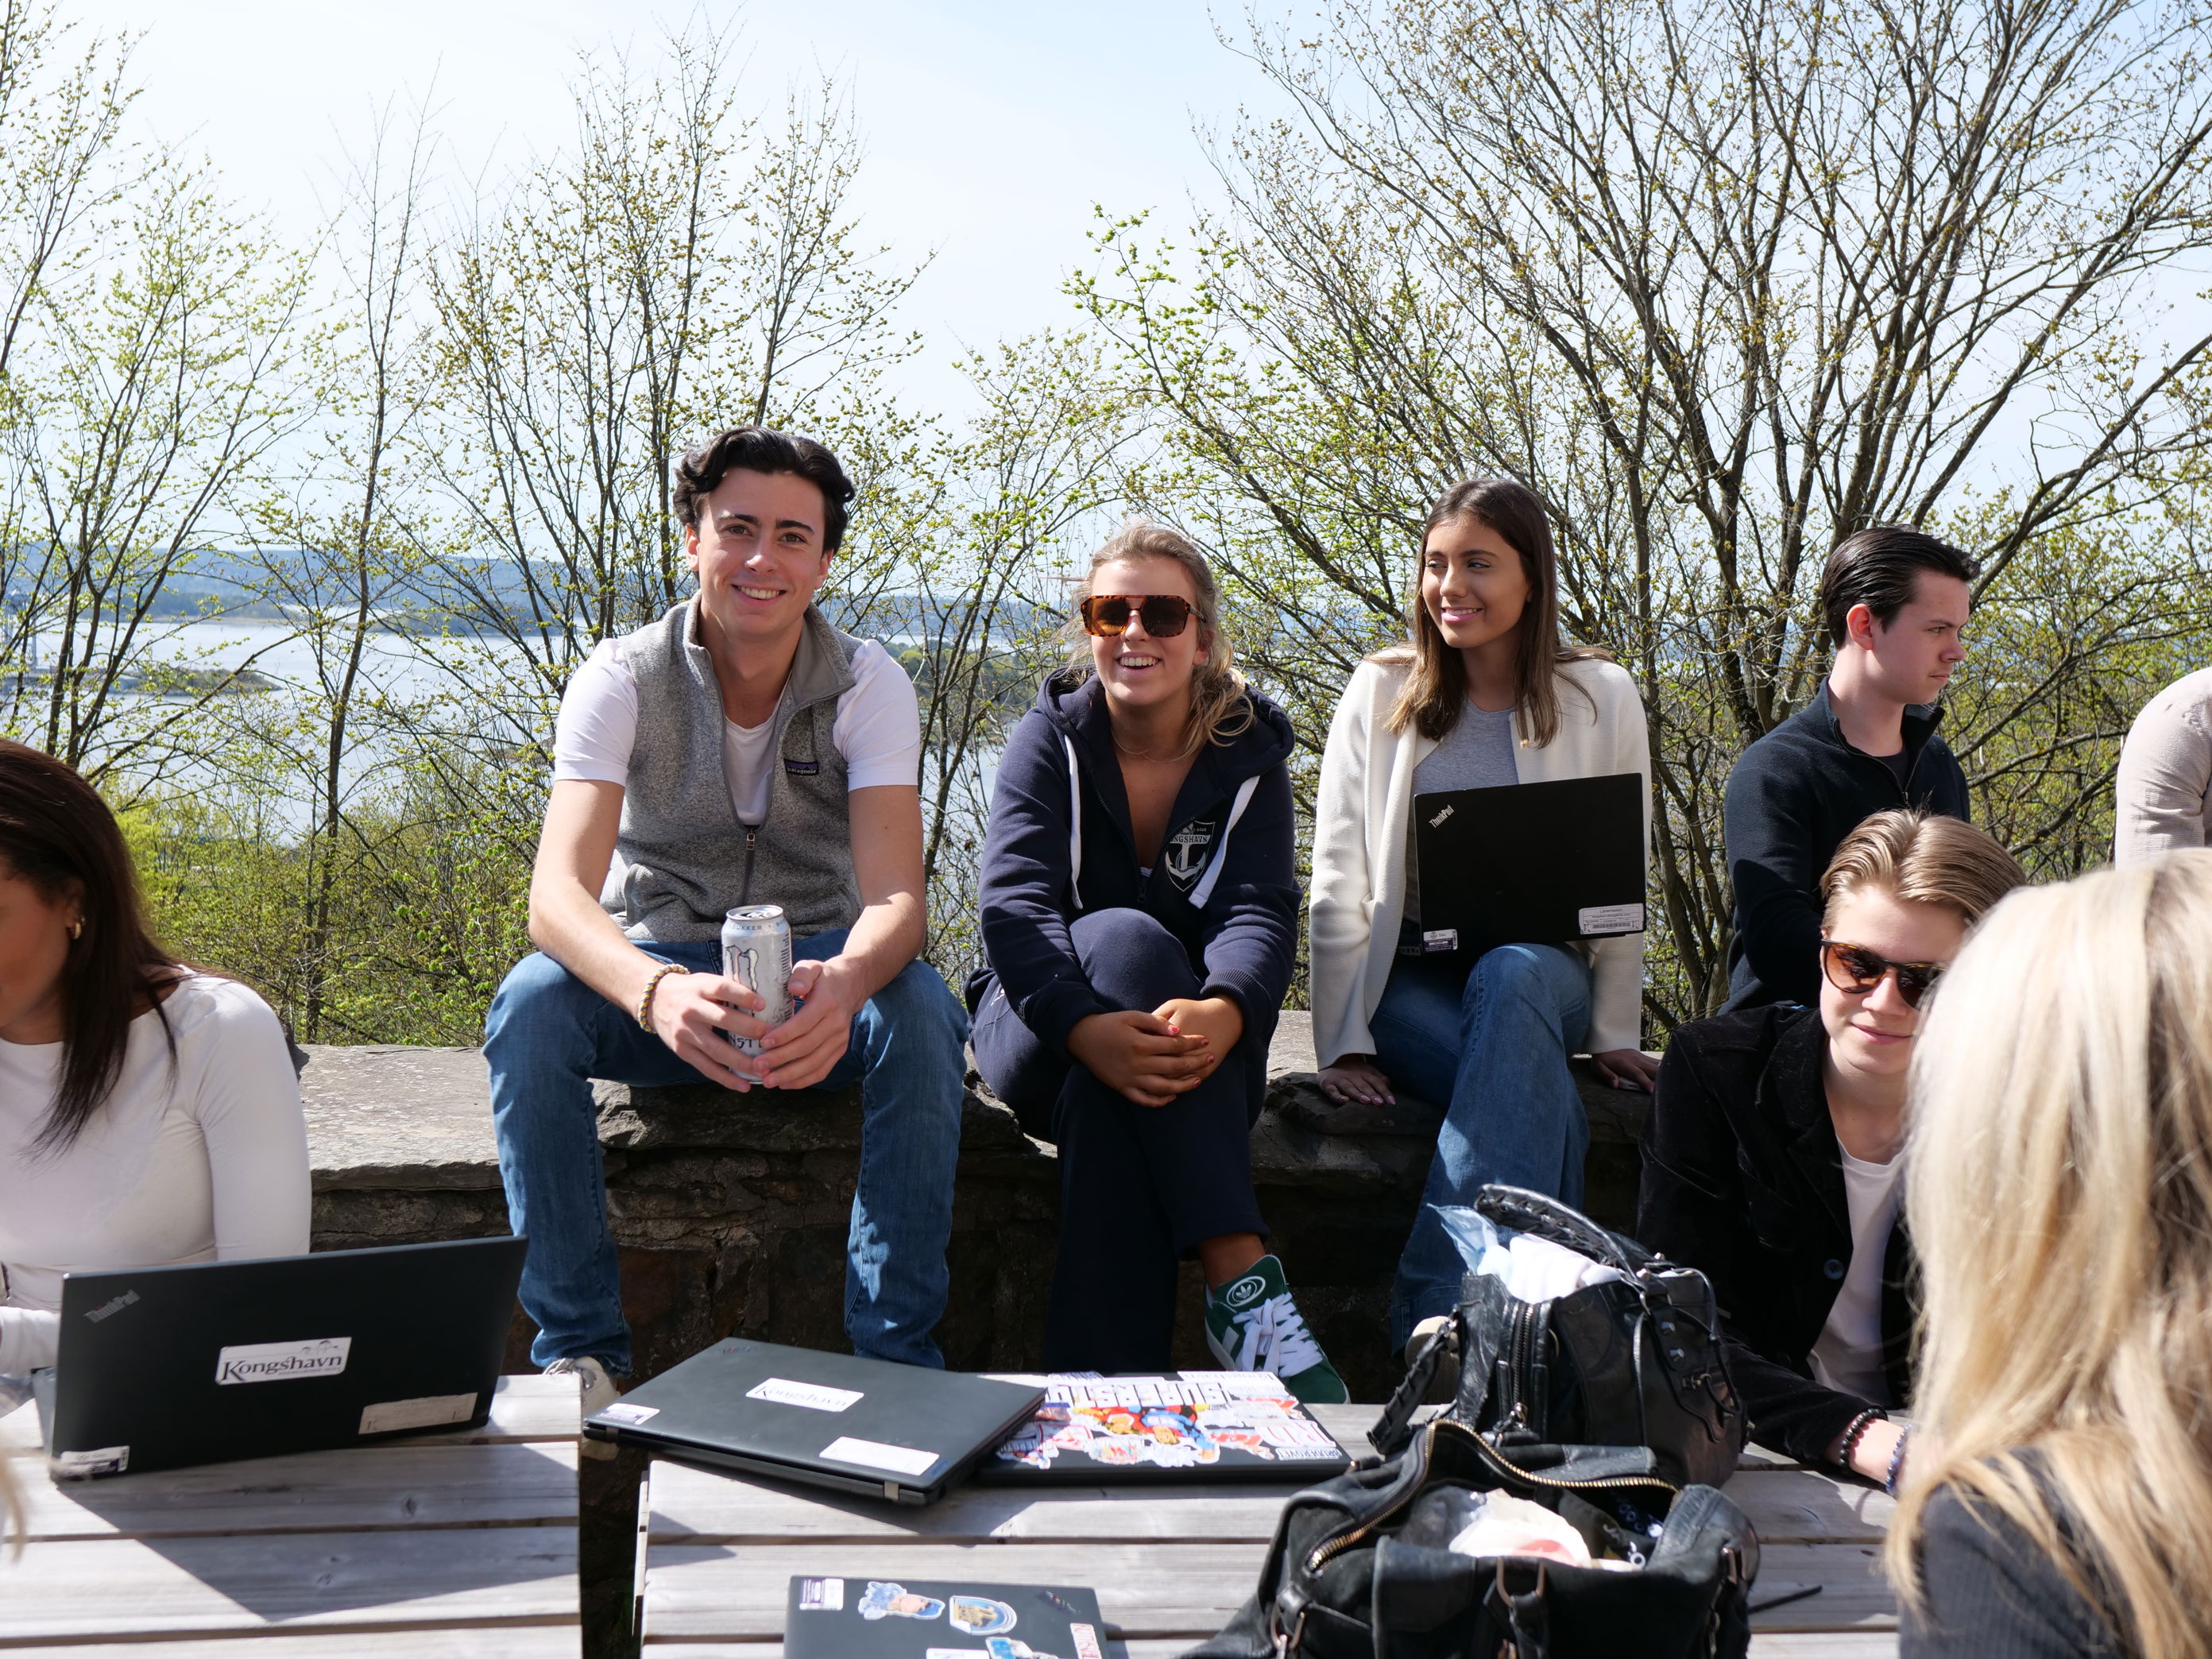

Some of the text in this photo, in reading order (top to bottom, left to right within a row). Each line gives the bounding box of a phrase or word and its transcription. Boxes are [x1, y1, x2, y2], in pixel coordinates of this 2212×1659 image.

[1429, 805, 1455, 828] ThinkPad
[83, 1290, 141, 1324] ThinkPad
[220, 1355, 342, 1382] Kongshavn
